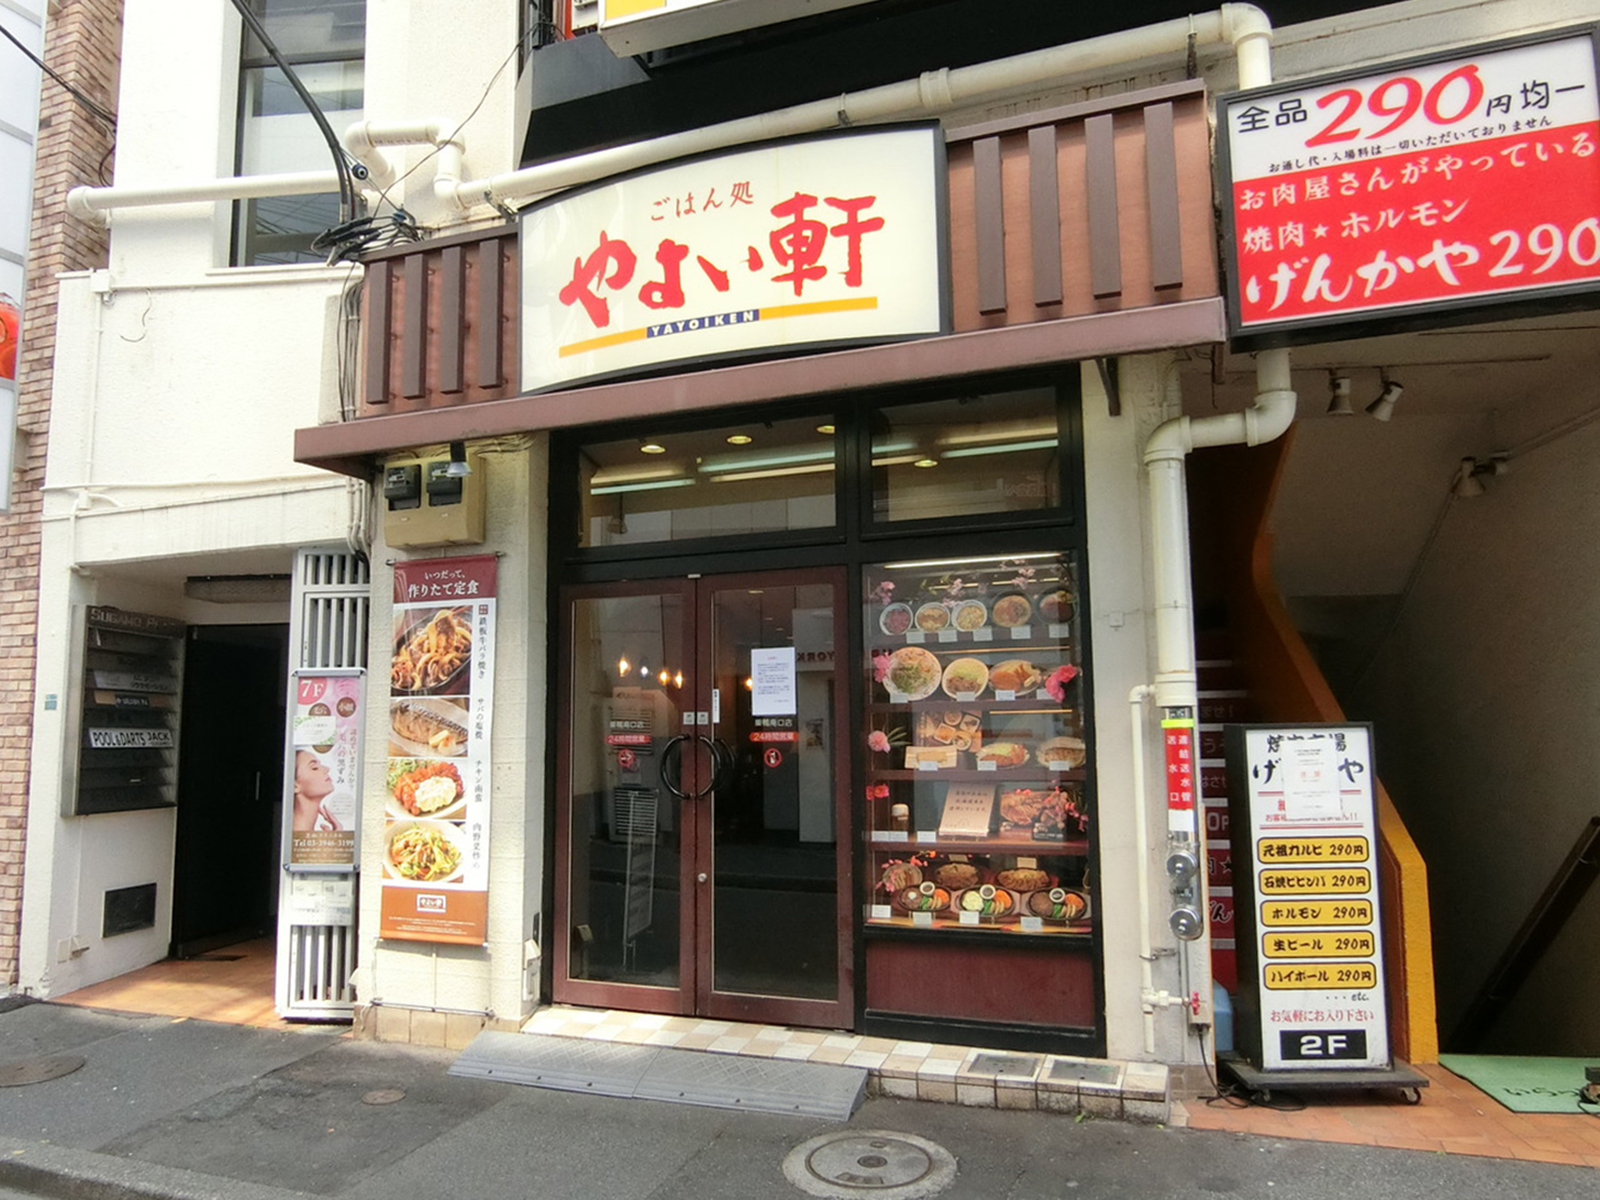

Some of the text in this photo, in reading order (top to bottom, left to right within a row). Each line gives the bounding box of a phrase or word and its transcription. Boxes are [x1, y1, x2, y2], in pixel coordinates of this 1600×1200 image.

[1240, 131, 1596, 211] お肉屋さんがやっている
[651, 181, 754, 221] ごはん処
[559, 192, 885, 328] やよい軒
[652, 309, 755, 337] YAYOIKEN
[408, 580, 480, 599] 作りたて定食
[147, 731, 170, 742] JACK
[1329, 843, 1364, 856] 290円
[1332, 875, 1366, 887] 290円
[1272, 906, 1368, 919] ホルモン 290円
[1335, 938, 1370, 950] 290円
[1337, 970, 1371, 982] 290円
[1270, 1008, 1375, 1023] お気軽にお入り下さい
[1300, 1035, 1347, 1056] 2F
